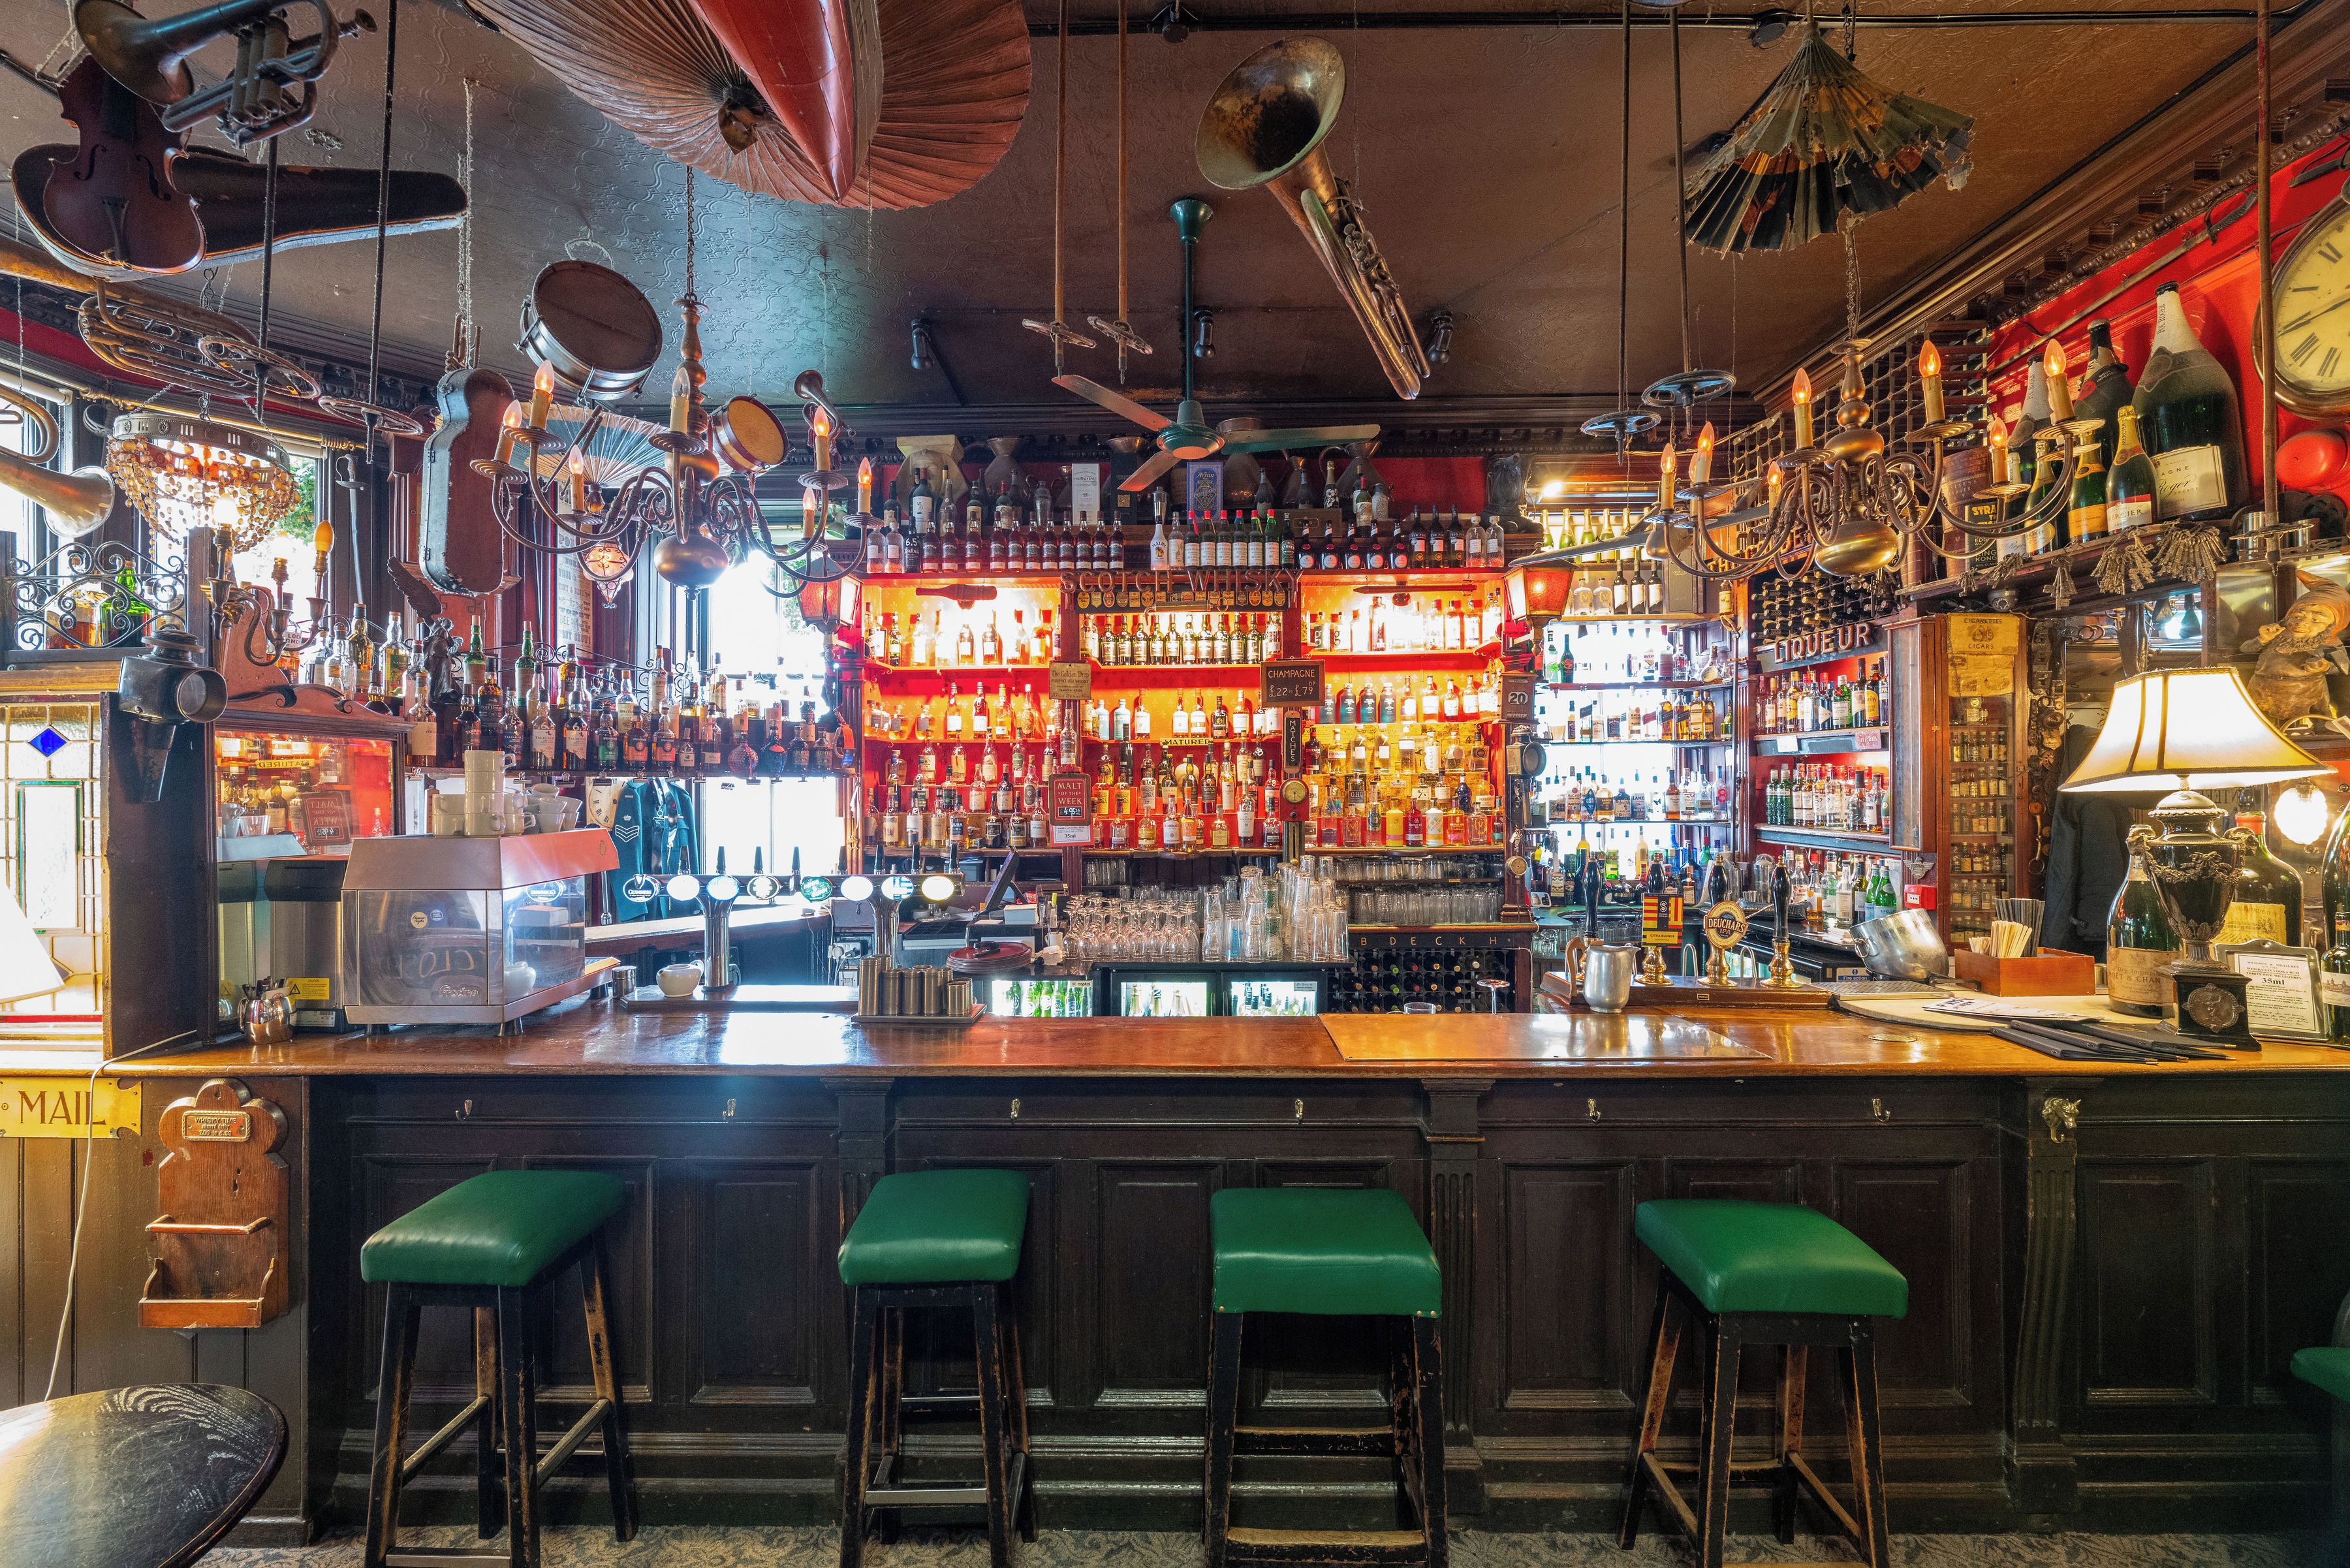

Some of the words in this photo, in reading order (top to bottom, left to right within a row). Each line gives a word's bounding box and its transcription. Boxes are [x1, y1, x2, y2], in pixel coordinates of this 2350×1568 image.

[1971, 504, 1996, 516] STRA
[1060, 571, 1174, 593] SCOTCH
[1187, 569, 1304, 593] WHISKY
[1774, 623, 1872, 663] LIQUEUR
[1078, 670, 1089, 679] Drop
[1268, 669, 1315, 678] CHAMPAGNE
[1269, 684, 1288, 697] £22
[1294, 684, 1313, 697] £79
[1509, 692, 1526, 704] 20
[1708, 918, 1746, 933] DEUCHARS
[439, 984, 478, 997] Fracino
[18, 1090, 107, 1125] MAIL
